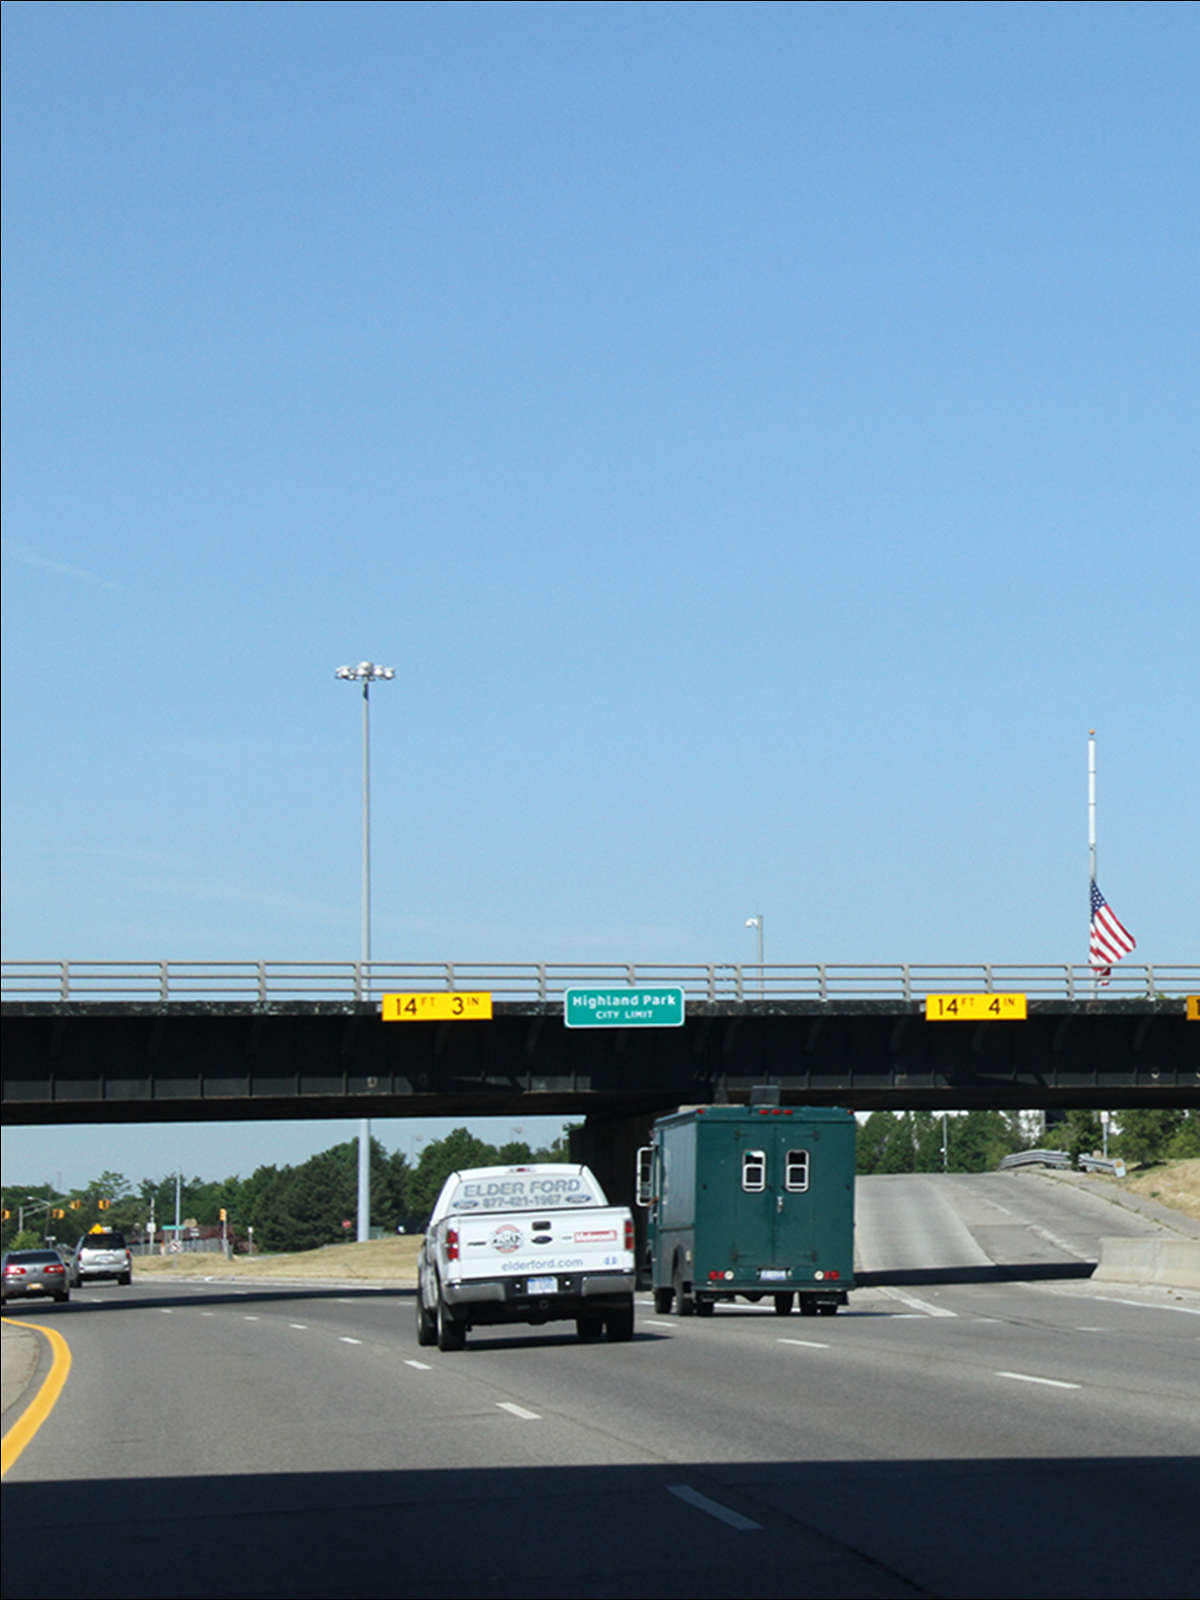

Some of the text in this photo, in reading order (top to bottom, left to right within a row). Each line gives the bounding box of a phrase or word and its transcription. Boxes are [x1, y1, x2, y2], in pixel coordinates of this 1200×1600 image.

[396, 996, 479, 1016] 14 FT 3 IN
[573, 995, 676, 1009] Highland Park
[939, 997, 1015, 1015] 14 FT 4 IN
[595, 1010, 653, 1019] CITY LIMIT
[464, 1179, 580, 1197] ELDER FORD
[502, 1258, 583, 1271] elderford.com
